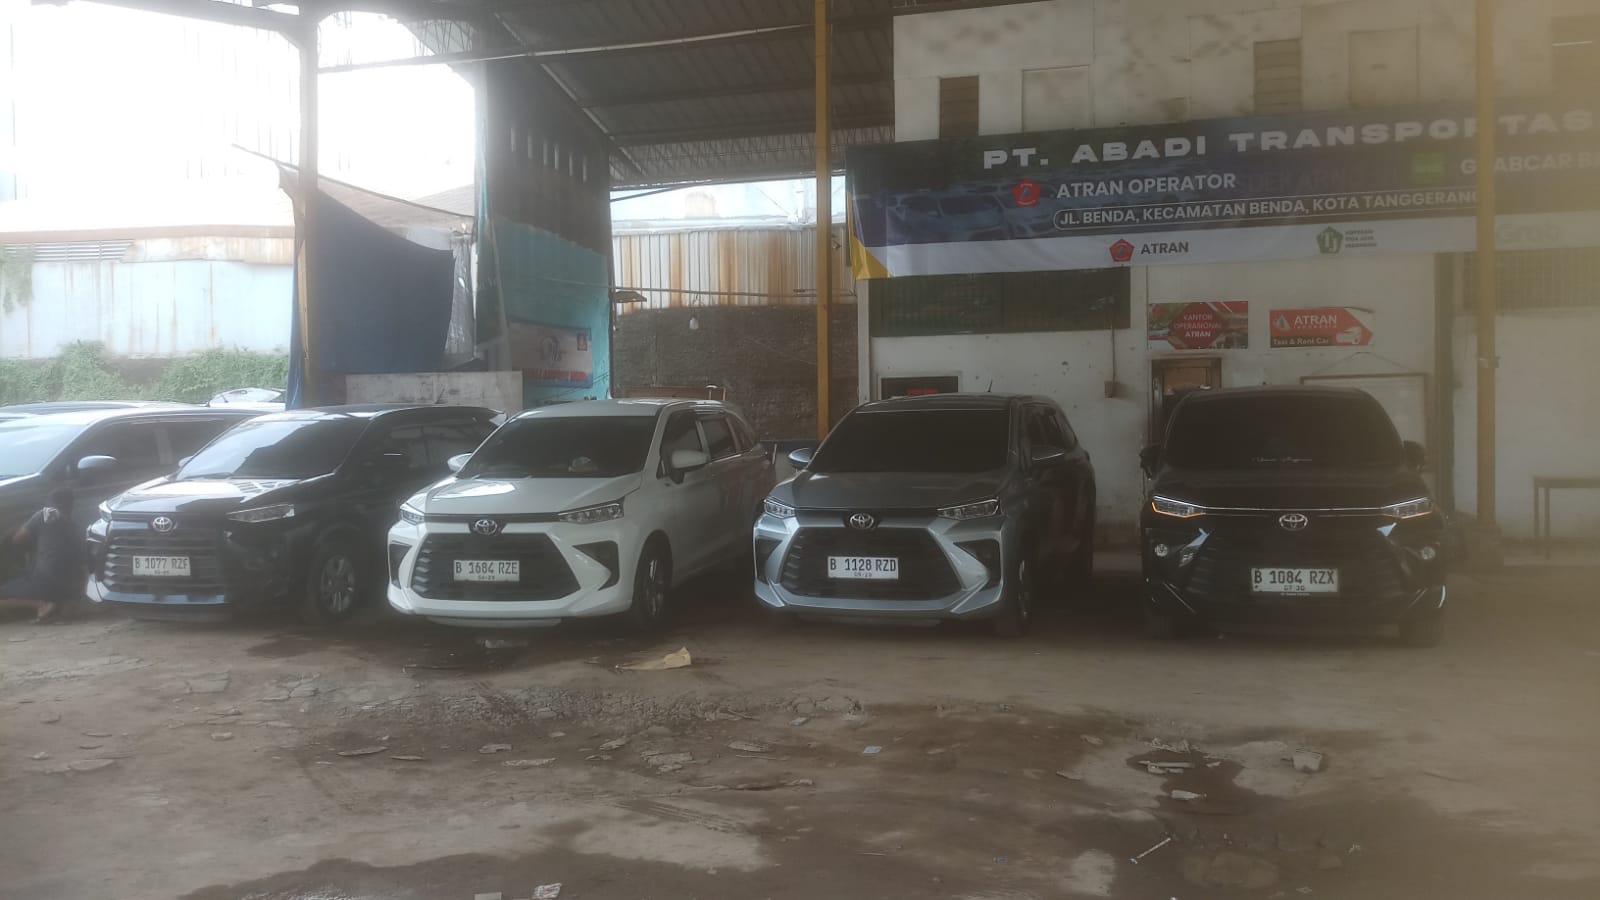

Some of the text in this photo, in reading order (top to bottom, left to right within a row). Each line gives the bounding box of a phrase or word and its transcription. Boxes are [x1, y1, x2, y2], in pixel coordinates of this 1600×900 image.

[983, 147, 1049, 169] PT.
[1071, 135, 1206, 164] ABADI
[1461, 154, 1571, 174] GABCAR
[1056, 179, 1124, 200] ATRAN
[1131, 172, 1236, 195] OPERATOR
[1060, 212, 1080, 226] JL.
[1083, 209, 1139, 225] BENDA,
[1143, 201, 1246, 221] KECAMATAN
[1249, 199, 1309, 216] BENDA,
[1313, 196, 1360, 211] KOTA
[1140, 241, 1189, 255] ATRAN
[1183, 313, 1213, 321] KANTOR
[1294, 314, 1337, 325] ATRAN
[1316, 336, 1330, 344] Car
[135, 557, 140, 569] B
[144, 558, 167, 569] 1077
[455, 561, 518, 575] B 1684 RZE
[830, 558, 897, 572] B 1128 RZD
[1254, 570, 1335, 585] B 1084 RZX
